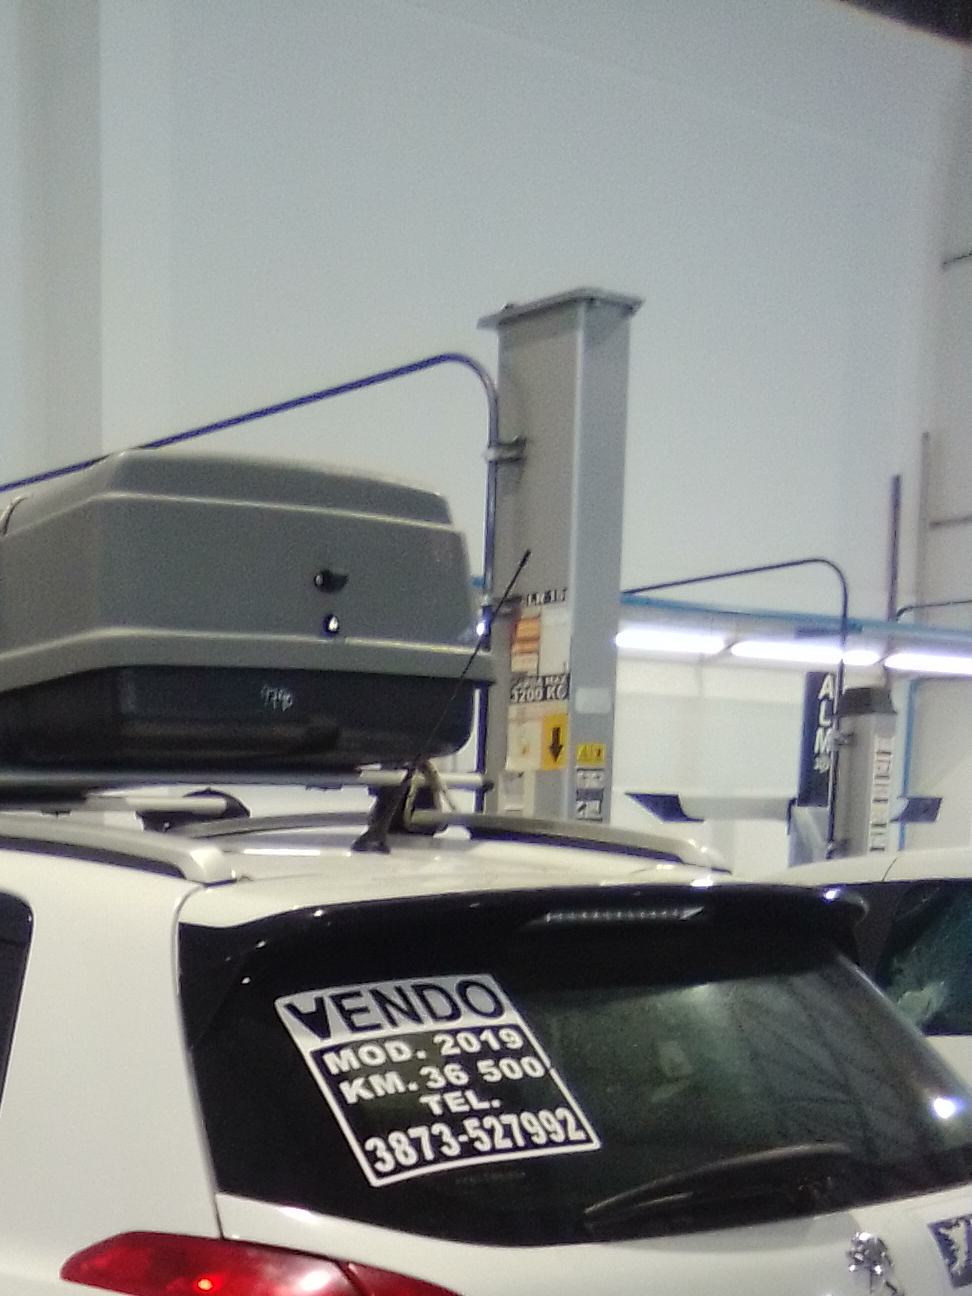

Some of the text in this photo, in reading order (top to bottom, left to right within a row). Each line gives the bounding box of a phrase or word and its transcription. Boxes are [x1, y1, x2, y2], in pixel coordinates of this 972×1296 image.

[284, 979, 505, 1040] VENDO
[322, 1027, 524, 1076] MOD. 2019
[338, 1055, 546, 1105] KM. 36 500
[420, 1091, 501, 1116] TEL.
[364, 1107, 587, 1174] 3873-527992
